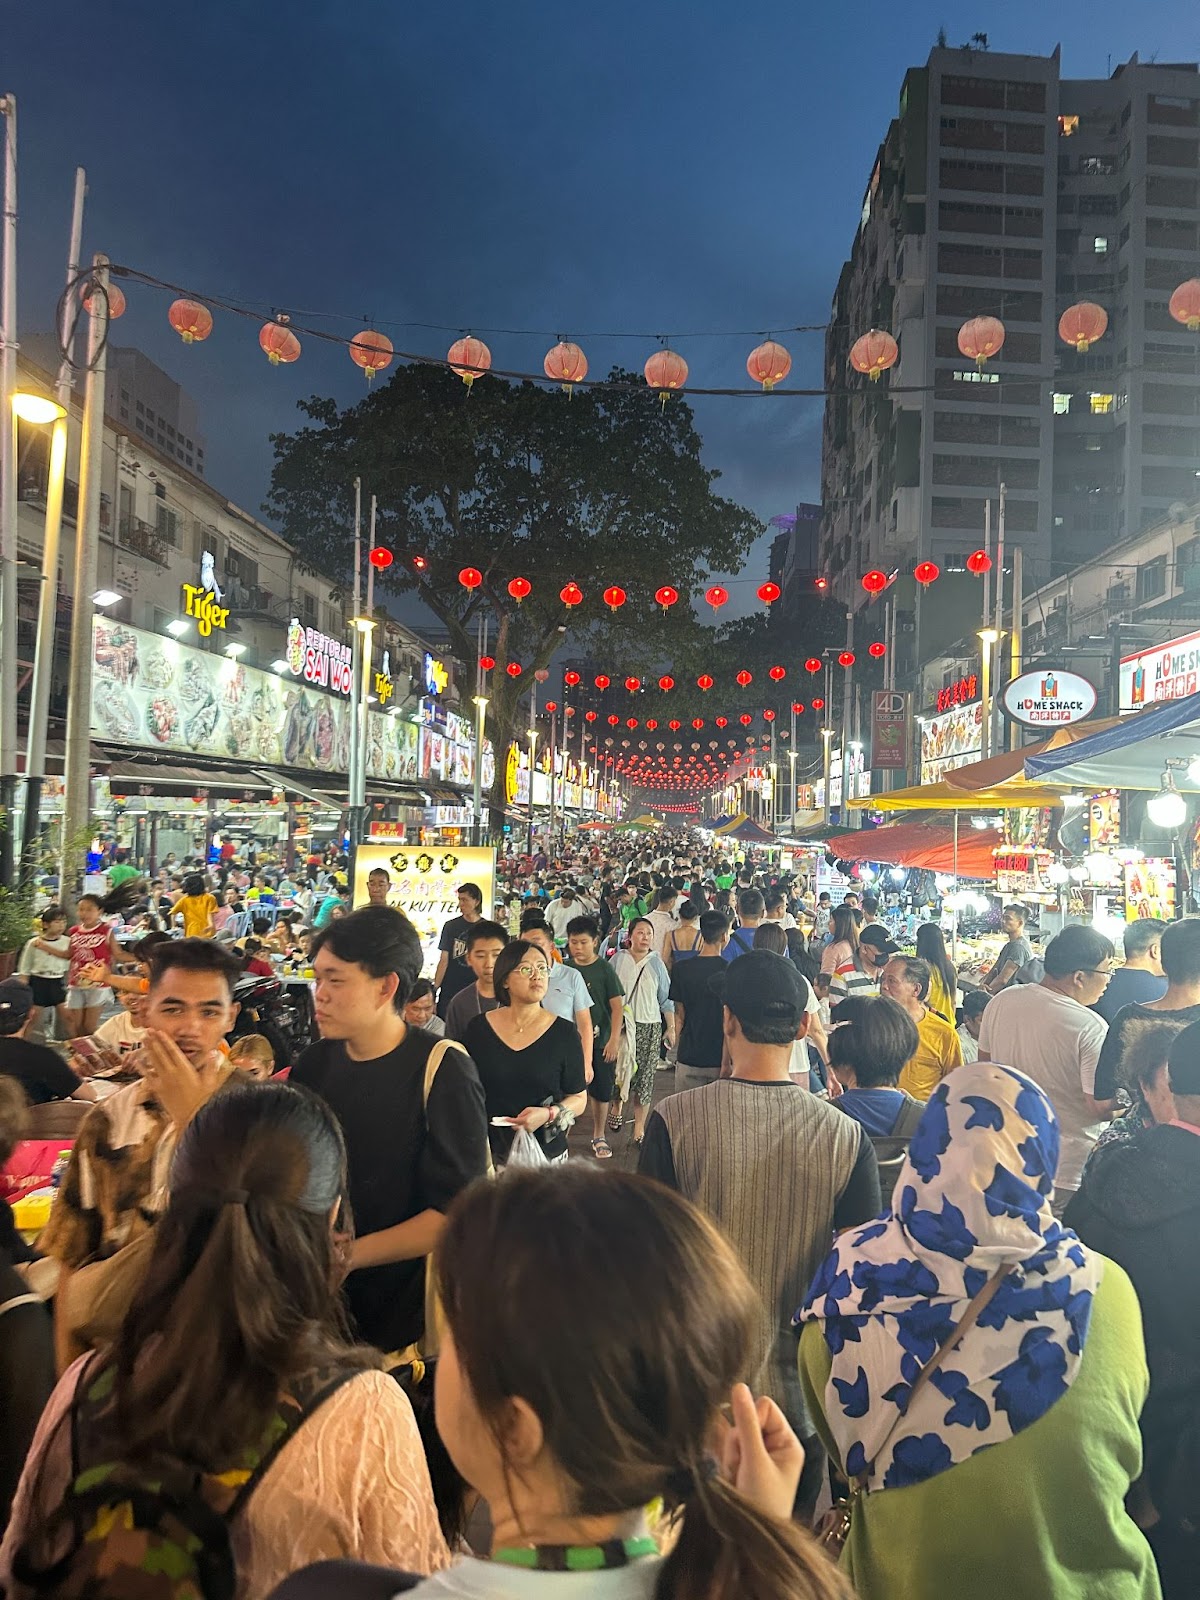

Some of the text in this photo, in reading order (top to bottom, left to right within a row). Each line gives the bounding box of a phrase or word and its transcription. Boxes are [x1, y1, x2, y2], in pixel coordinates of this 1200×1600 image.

[183, 583, 230, 637] Tiger
[306, 627, 352, 665] RESTORAN
[304, 648, 329, 687] SAI
[330, 657, 355, 695] WO
[1155, 652, 1186, 680] HOME
[375, 673, 393, 704] Tiger
[877, 693, 905, 713] 4D
[1017, 699, 1083, 711] HOME SHACK
[749, 767, 764, 779] KK
[408, 900, 438, 913] KUT
